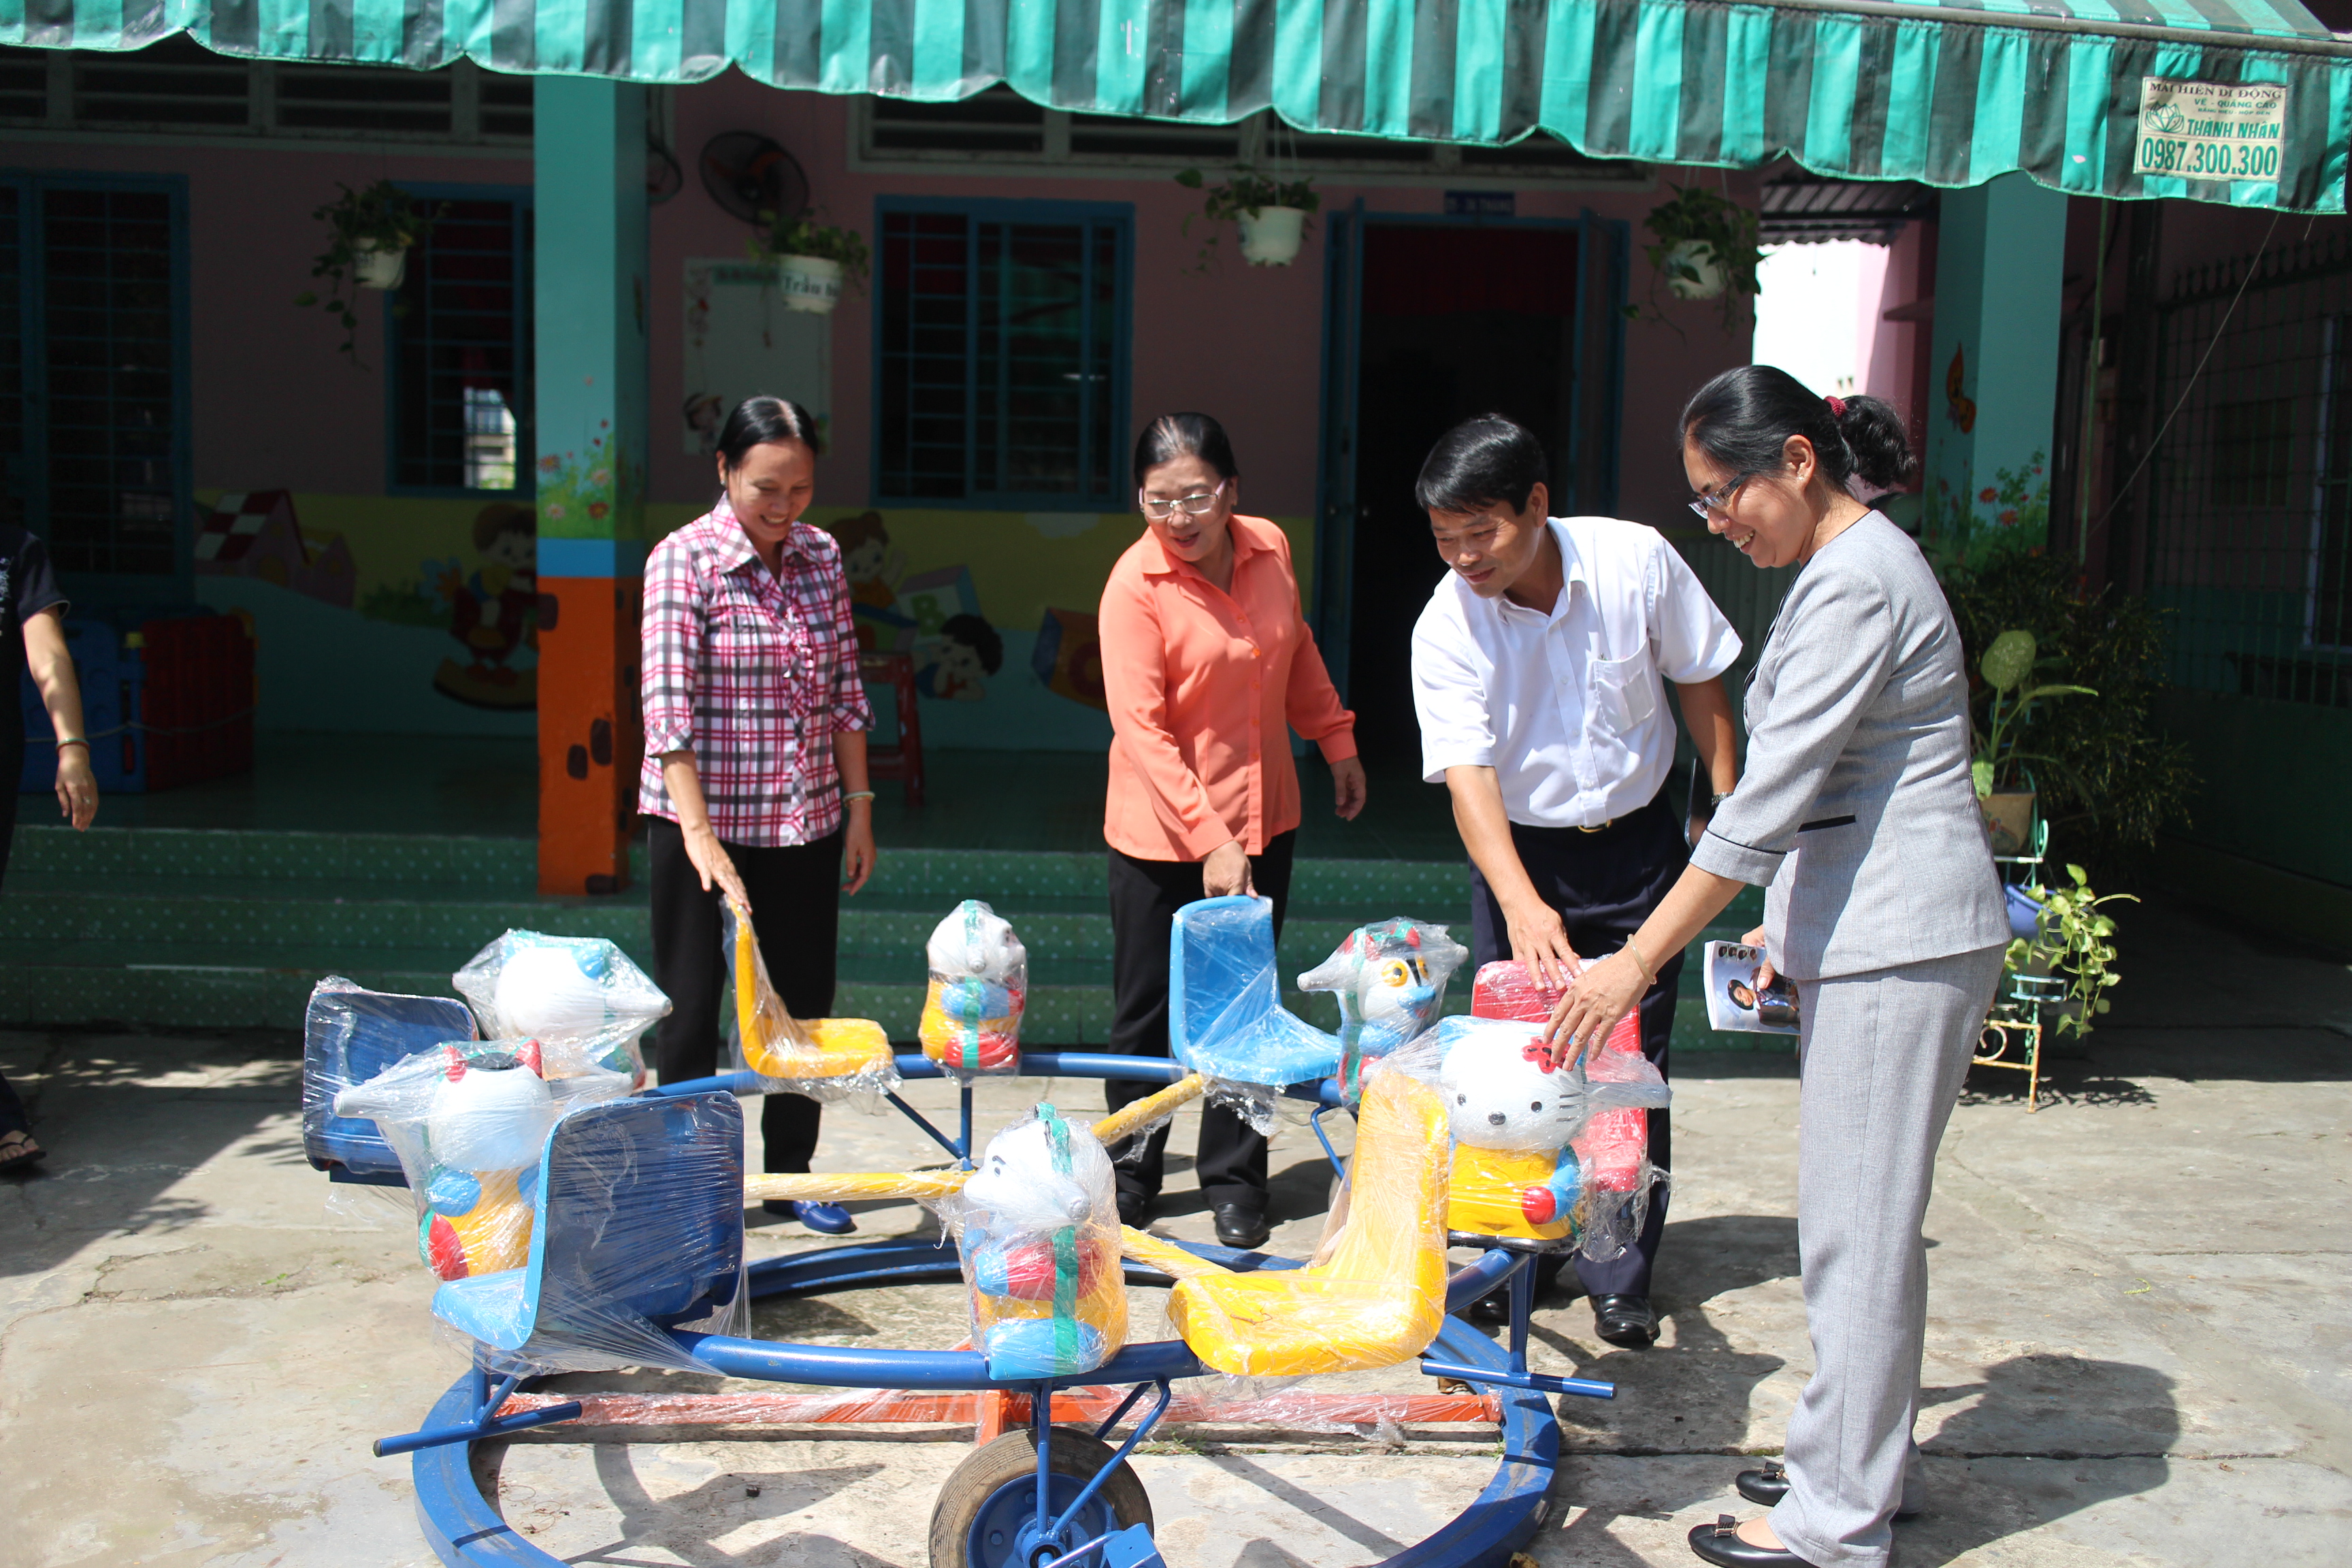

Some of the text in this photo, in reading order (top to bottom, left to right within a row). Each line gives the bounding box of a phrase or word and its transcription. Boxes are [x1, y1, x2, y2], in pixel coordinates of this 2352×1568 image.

[2178, 84, 2214, 95] HIÊN
[2219, 88, 2234, 97] DI
[2238, 87, 2281, 100] ĐỘNG
[2237, 120, 2281, 139] NHÂN
[2142, 137, 2278, 176] 0987.300.300
